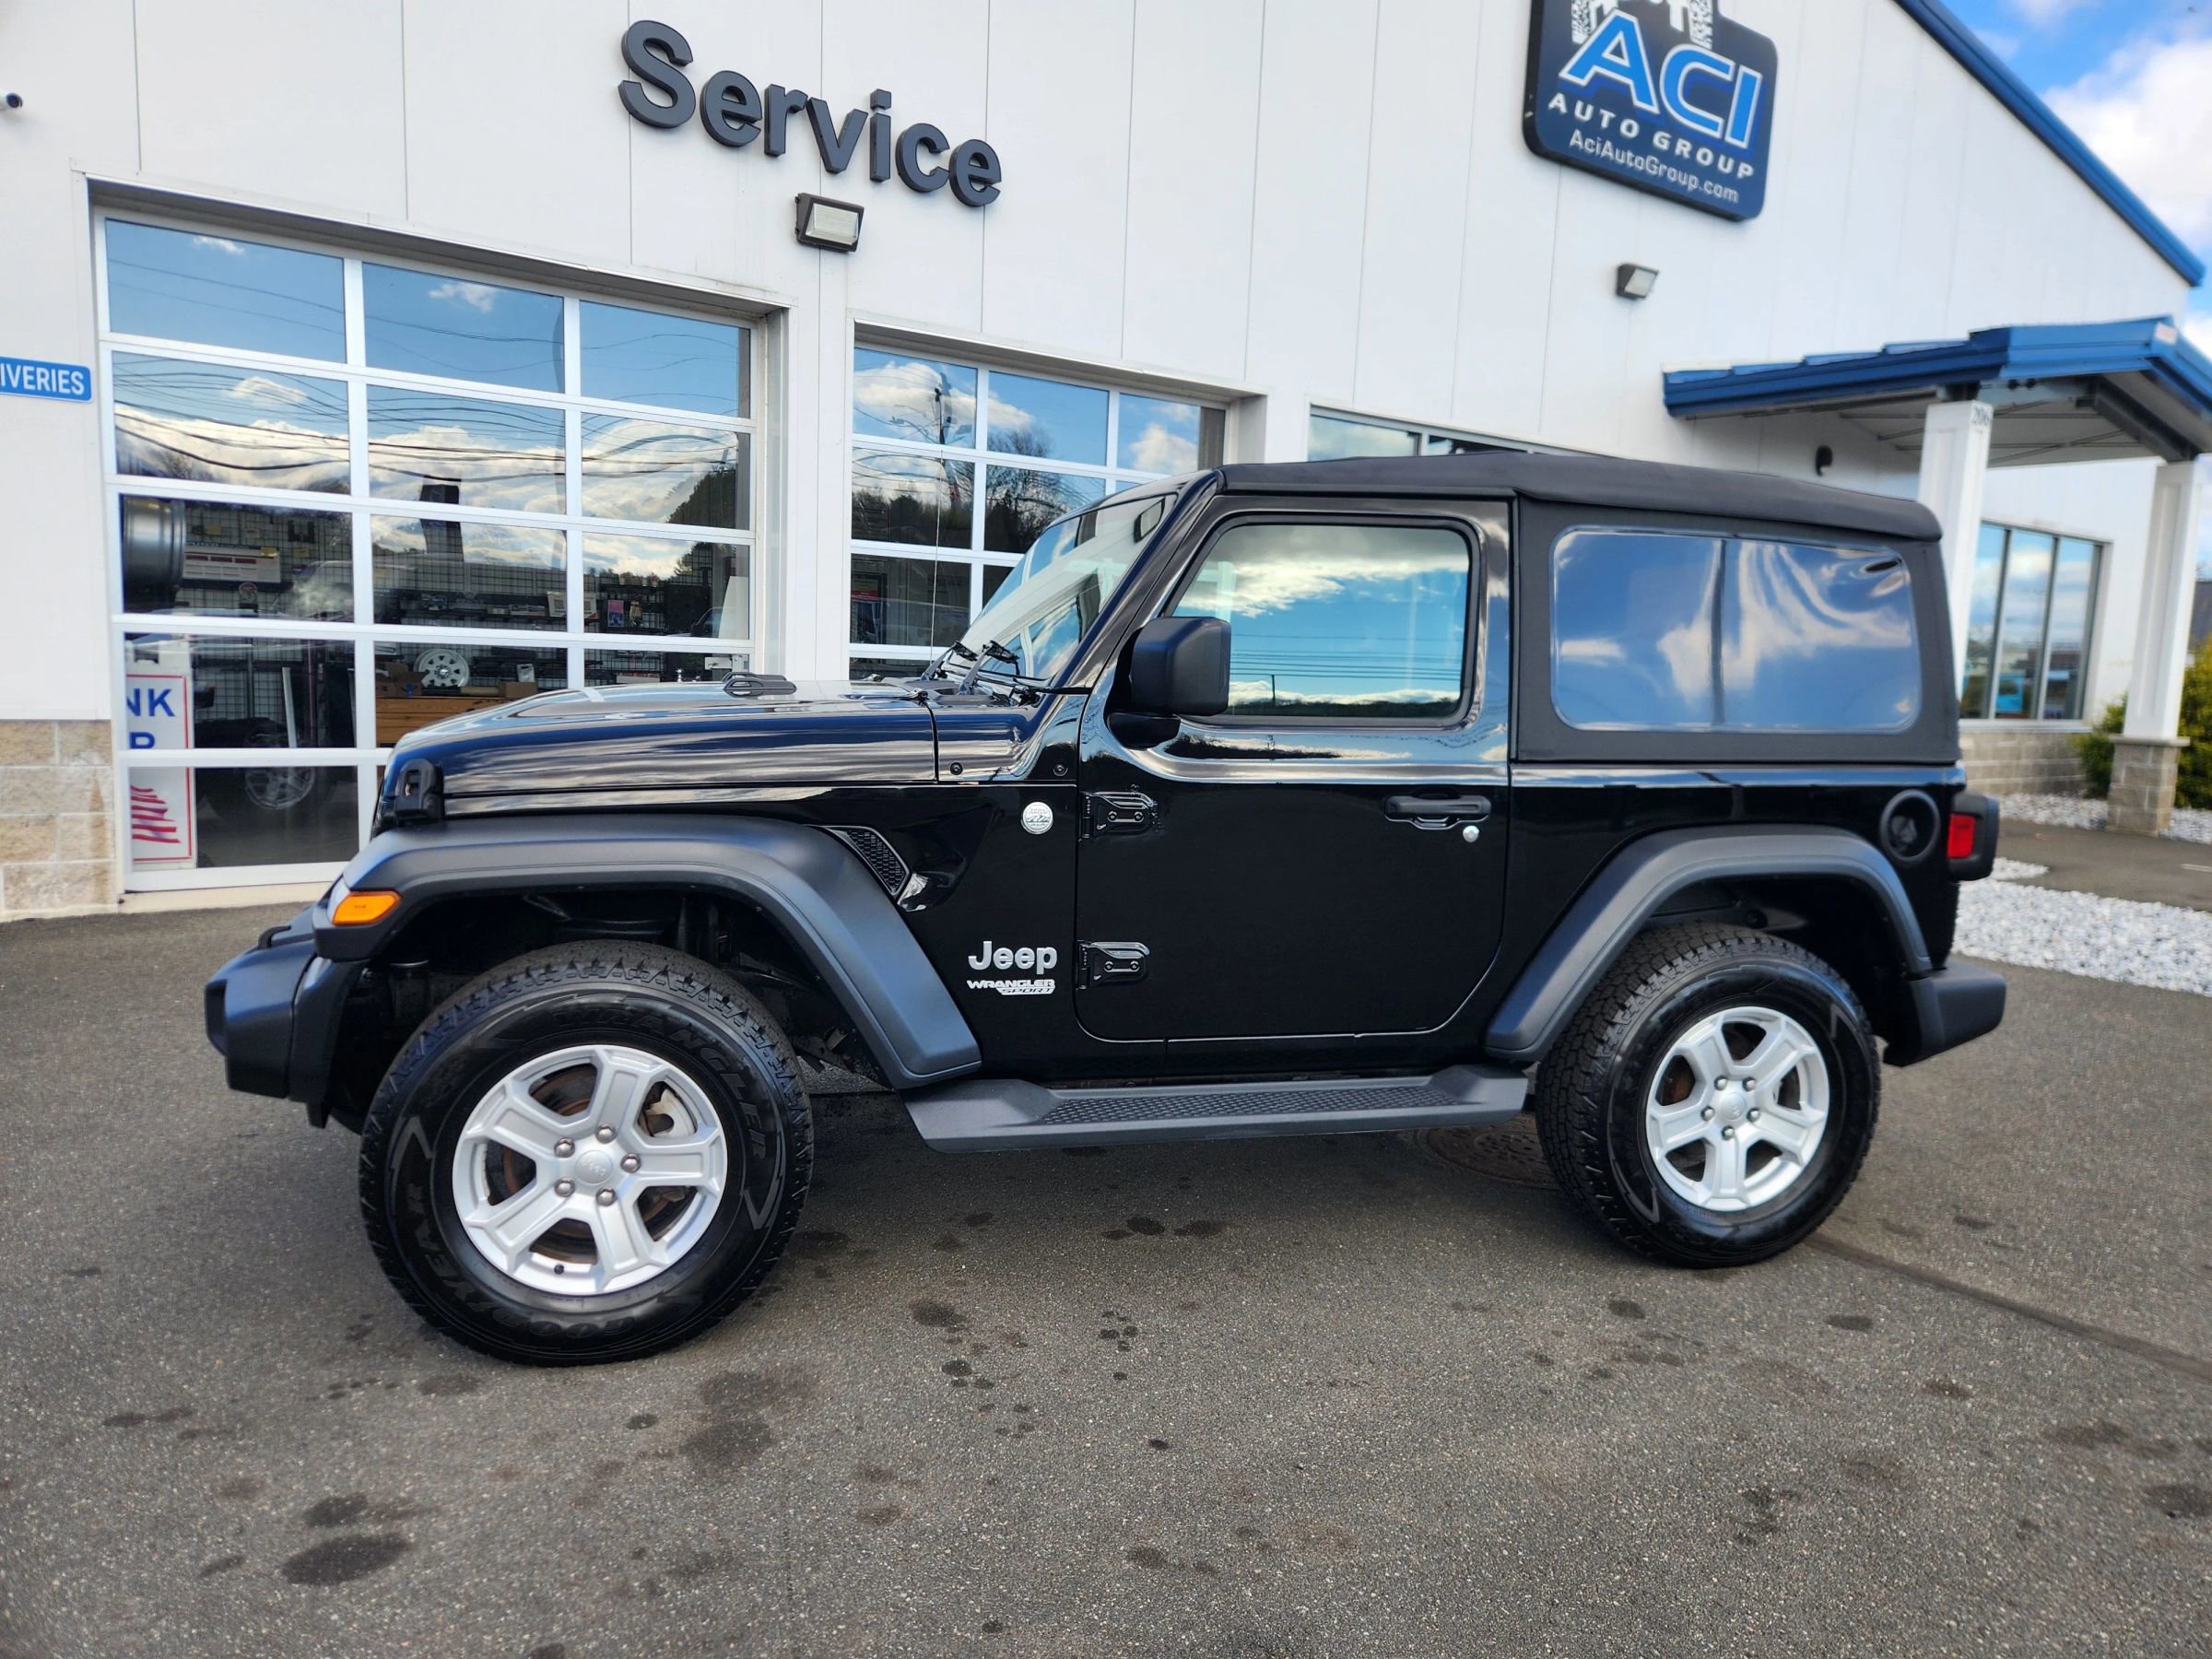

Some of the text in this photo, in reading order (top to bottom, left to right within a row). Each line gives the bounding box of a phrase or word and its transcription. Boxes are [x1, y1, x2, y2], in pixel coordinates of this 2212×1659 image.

[1558, 8, 1762, 149] ACI
[618, 19, 1002, 207] Service
[1547, 92, 1755, 179] AUTO GROUP
[1569, 129, 1739, 204] AciAutoGroup.com
[0, 362, 85, 395] IVERIES
[966, 979, 1056, 989] WRANGLER
[968, 940, 1058, 975] Jeep
[998, 987, 1054, 995] SPORT
